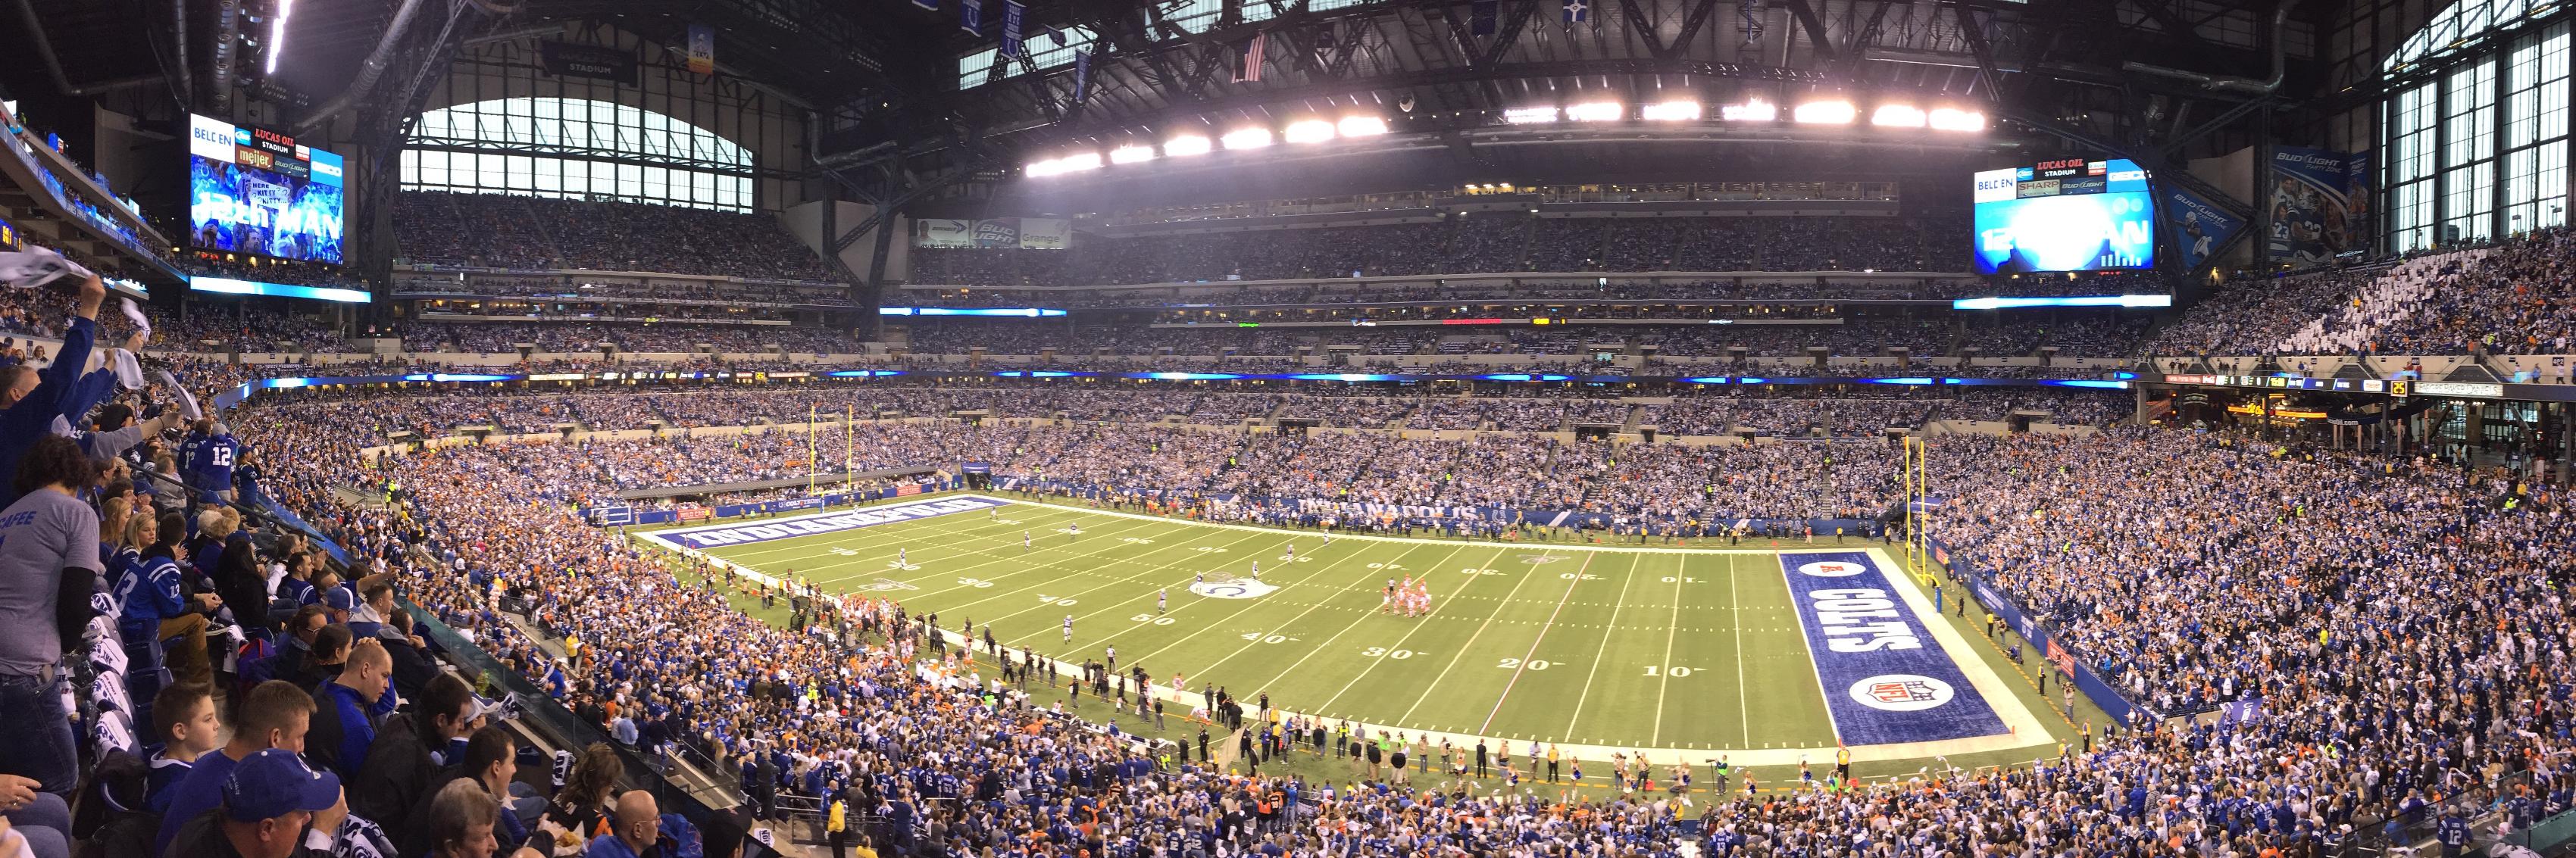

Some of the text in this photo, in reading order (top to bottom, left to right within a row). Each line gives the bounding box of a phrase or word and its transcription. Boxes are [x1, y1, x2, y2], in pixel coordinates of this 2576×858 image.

[570, 63, 611, 74] STADIUM
[255, 128, 280, 143] LUCAS
[281, 136, 295, 147] OIL
[261, 141, 289, 154] STADIUM
[239, 149, 270, 167] meijer
[2037, 158, 2084, 170] LUCAS OIL
[2276, 152, 2302, 162] BUD
[2307, 156, 2340, 167] LIGHT
[274, 160, 308, 173] BUD LIGHT
[2044, 168, 2076, 177] STADIUM
[2327, 165, 2343, 174] ZONE
[2018, 181, 2059, 191] SHARP
[2174, 193, 2227, 223] BUD LIGHT
[275, 203, 340, 240] MAN
[979, 224, 1014, 235] BUD
[1023, 233, 1061, 244] Grange
[2393, 382, 2405, 394] 25
[213, 446, 232, 466] 12
[679, 498, 996, 545] INDIANAPOLIS
[170, 583, 180, 599] 13
[1037, 594, 1078, 607] 40
[1130, 613, 1176, 626] 50
[1809, 588, 1924, 653] COLTS
[1240, 632, 1286, 644] 40
[1361, 646, 1413, 660] 30
[1496, 657, 1550, 671] 20
[1642, 665, 1692, 678] 10
[1873, 682, 1909, 701] NFL
[2448, 829, 2462, 845] 12
